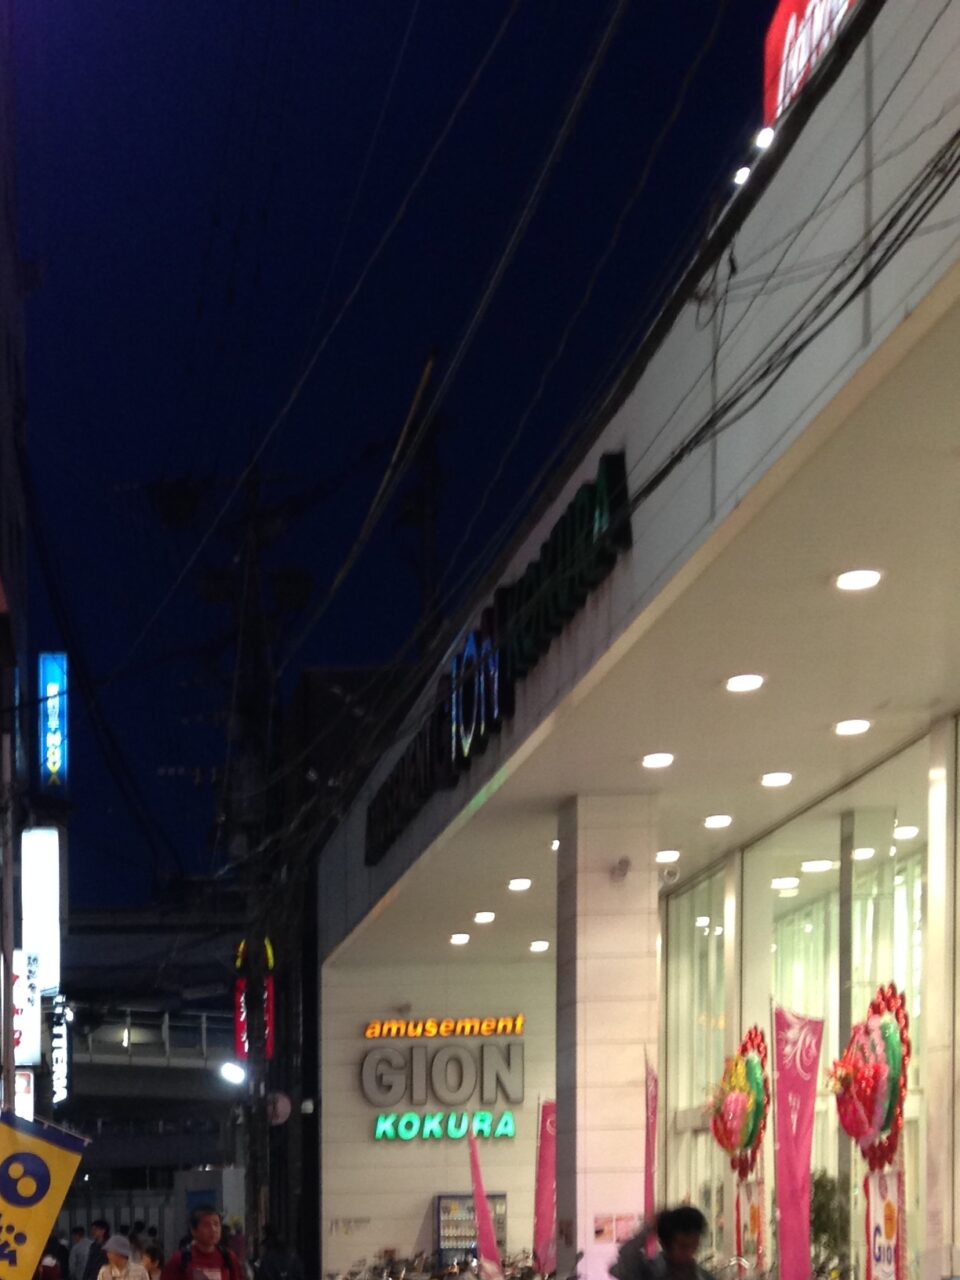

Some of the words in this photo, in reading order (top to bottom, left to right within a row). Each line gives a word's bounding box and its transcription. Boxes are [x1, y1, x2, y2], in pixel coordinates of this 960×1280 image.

[365, 1013, 525, 1038] amusement
[361, 1043, 525, 1107] GION
[374, 1110, 516, 1140] KOKURA
